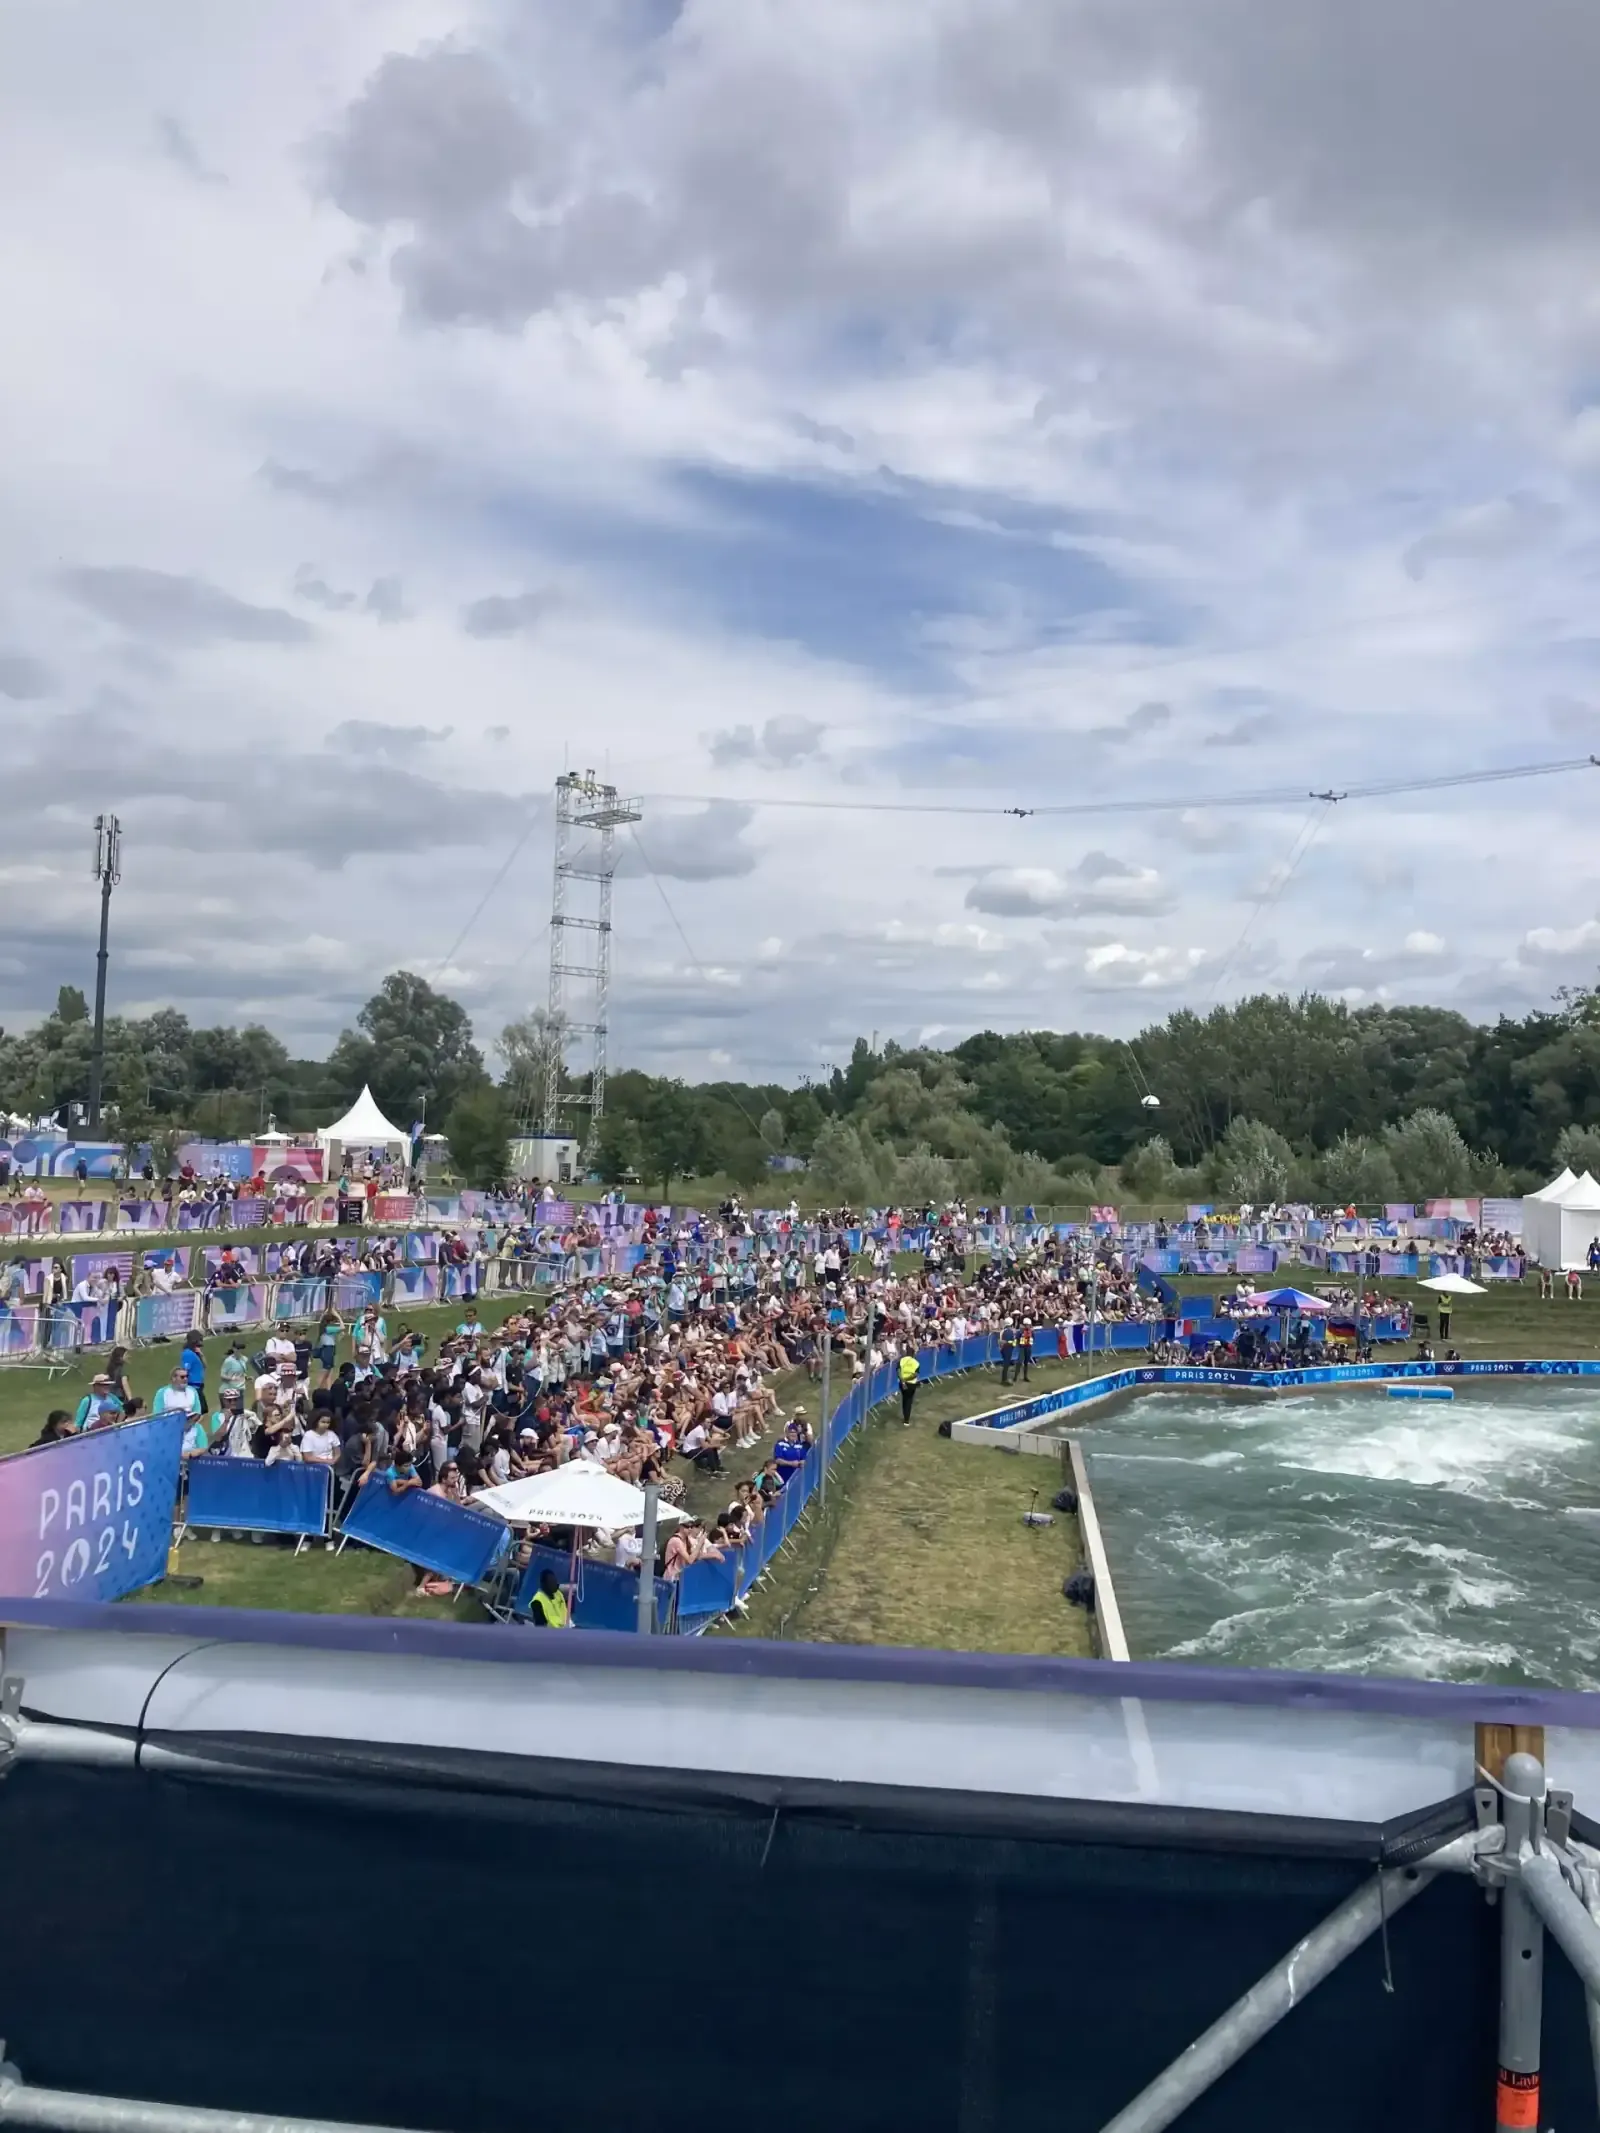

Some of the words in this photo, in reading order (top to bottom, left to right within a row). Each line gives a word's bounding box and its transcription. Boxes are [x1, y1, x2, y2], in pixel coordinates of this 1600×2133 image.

[1470, 1364, 1492, 1373] PARIS
[1494, 1364, 1514, 1372] 2024
[1175, 1370, 1204, 1380] PARIS
[1207, 1372, 1236, 1381] 2024
[528, 1508, 566, 1518] PARIS
[570, 1512, 603, 1522] 2024
[32, 1520, 138, 1599] 2024
